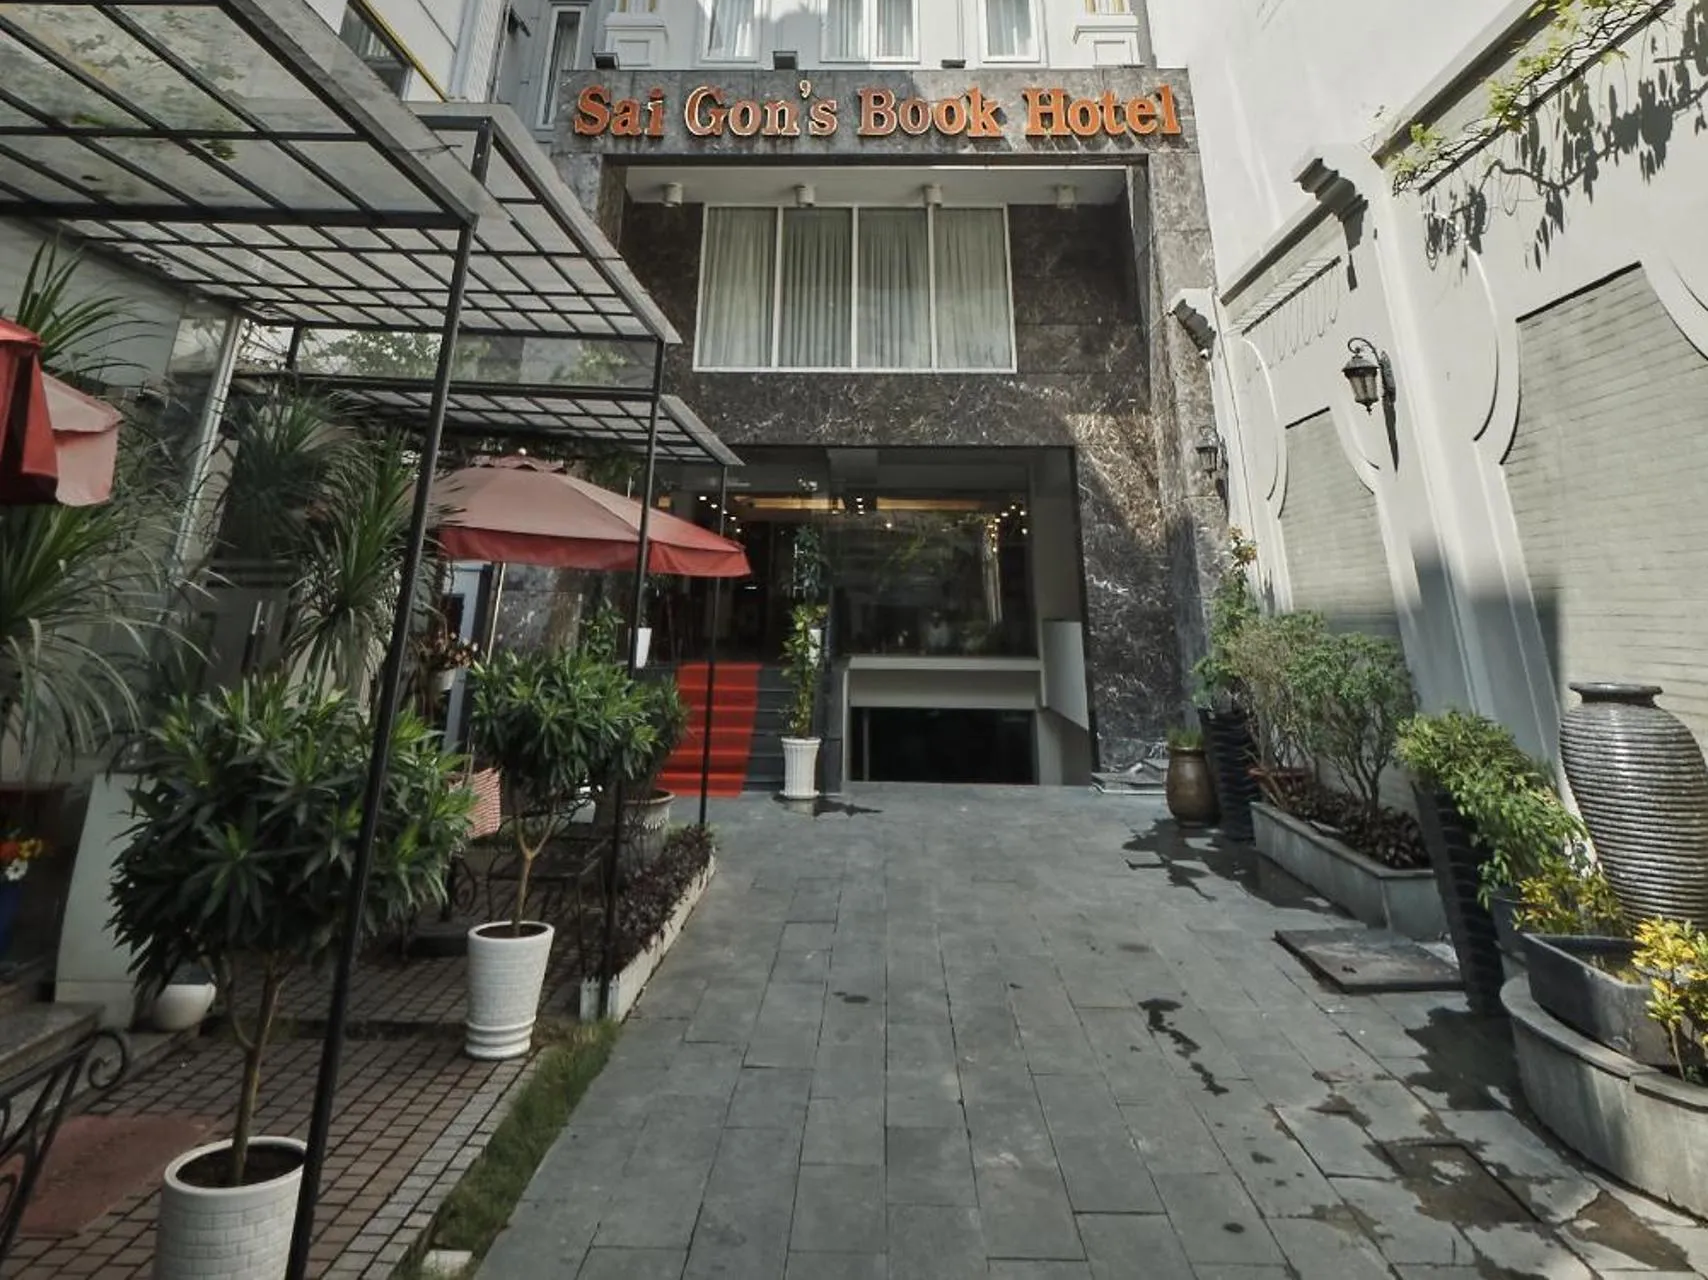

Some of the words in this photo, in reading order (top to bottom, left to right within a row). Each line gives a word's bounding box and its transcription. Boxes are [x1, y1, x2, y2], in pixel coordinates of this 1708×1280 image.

[574, 84, 664, 137] Sai
[684, 79, 837, 137] Gon's
[857, 84, 1003, 137] Book
[1022, 84, 1182, 136] Hotel
